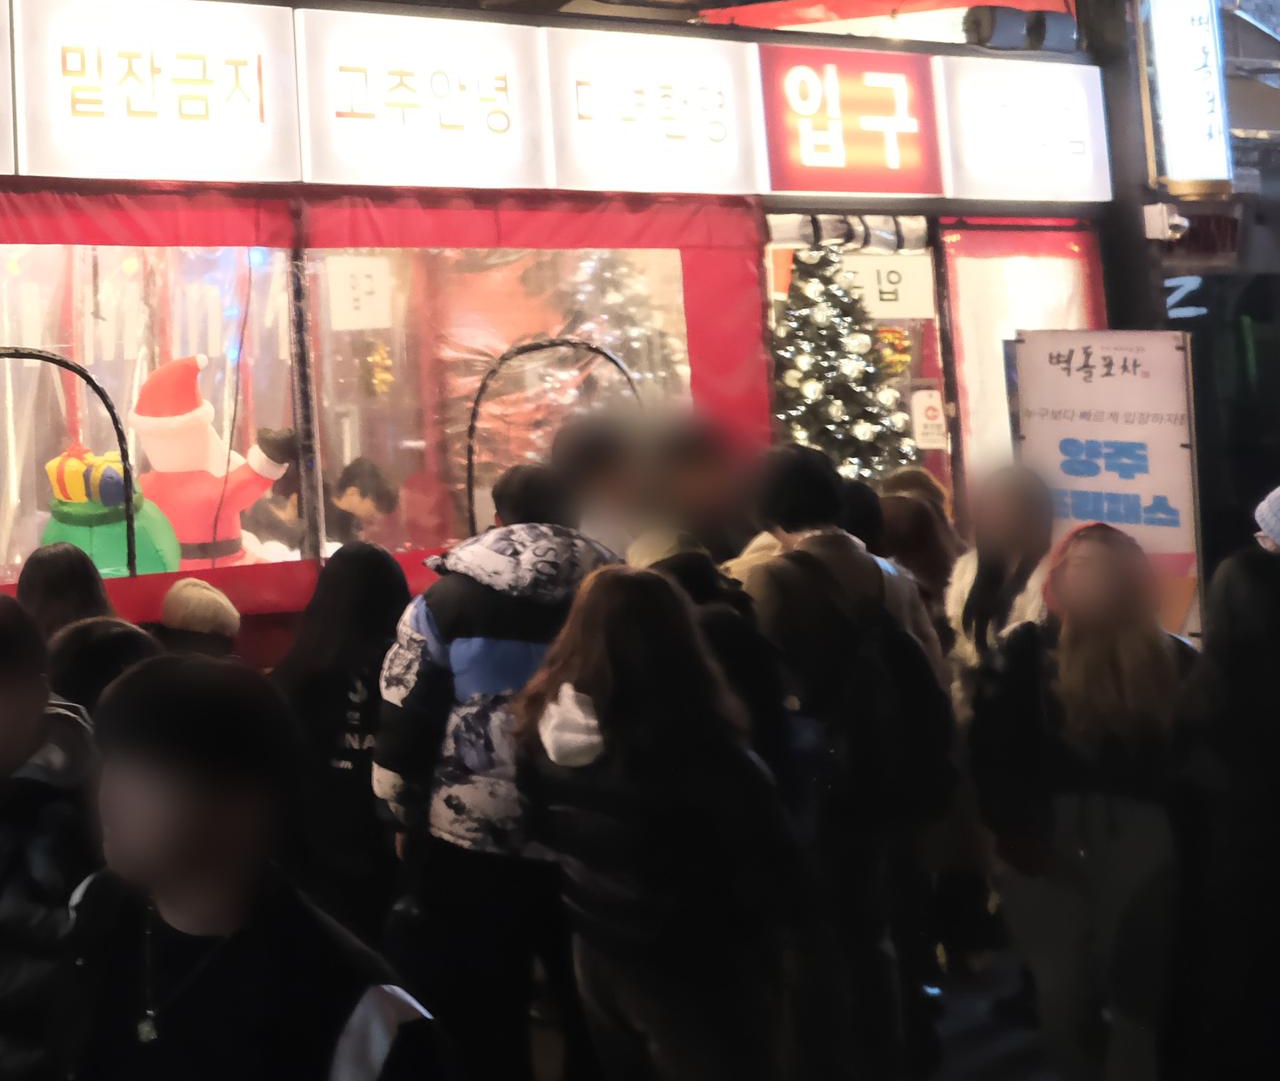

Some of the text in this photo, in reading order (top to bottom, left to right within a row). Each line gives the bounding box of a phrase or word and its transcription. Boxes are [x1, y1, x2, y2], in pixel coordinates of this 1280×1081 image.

[59, 44, 266, 124] 밑잔금지
[784, 63, 919, 170] 입구
[1048, 345, 1141, 383] 벽돌포차
[1058, 437, 1150, 480] 양주
